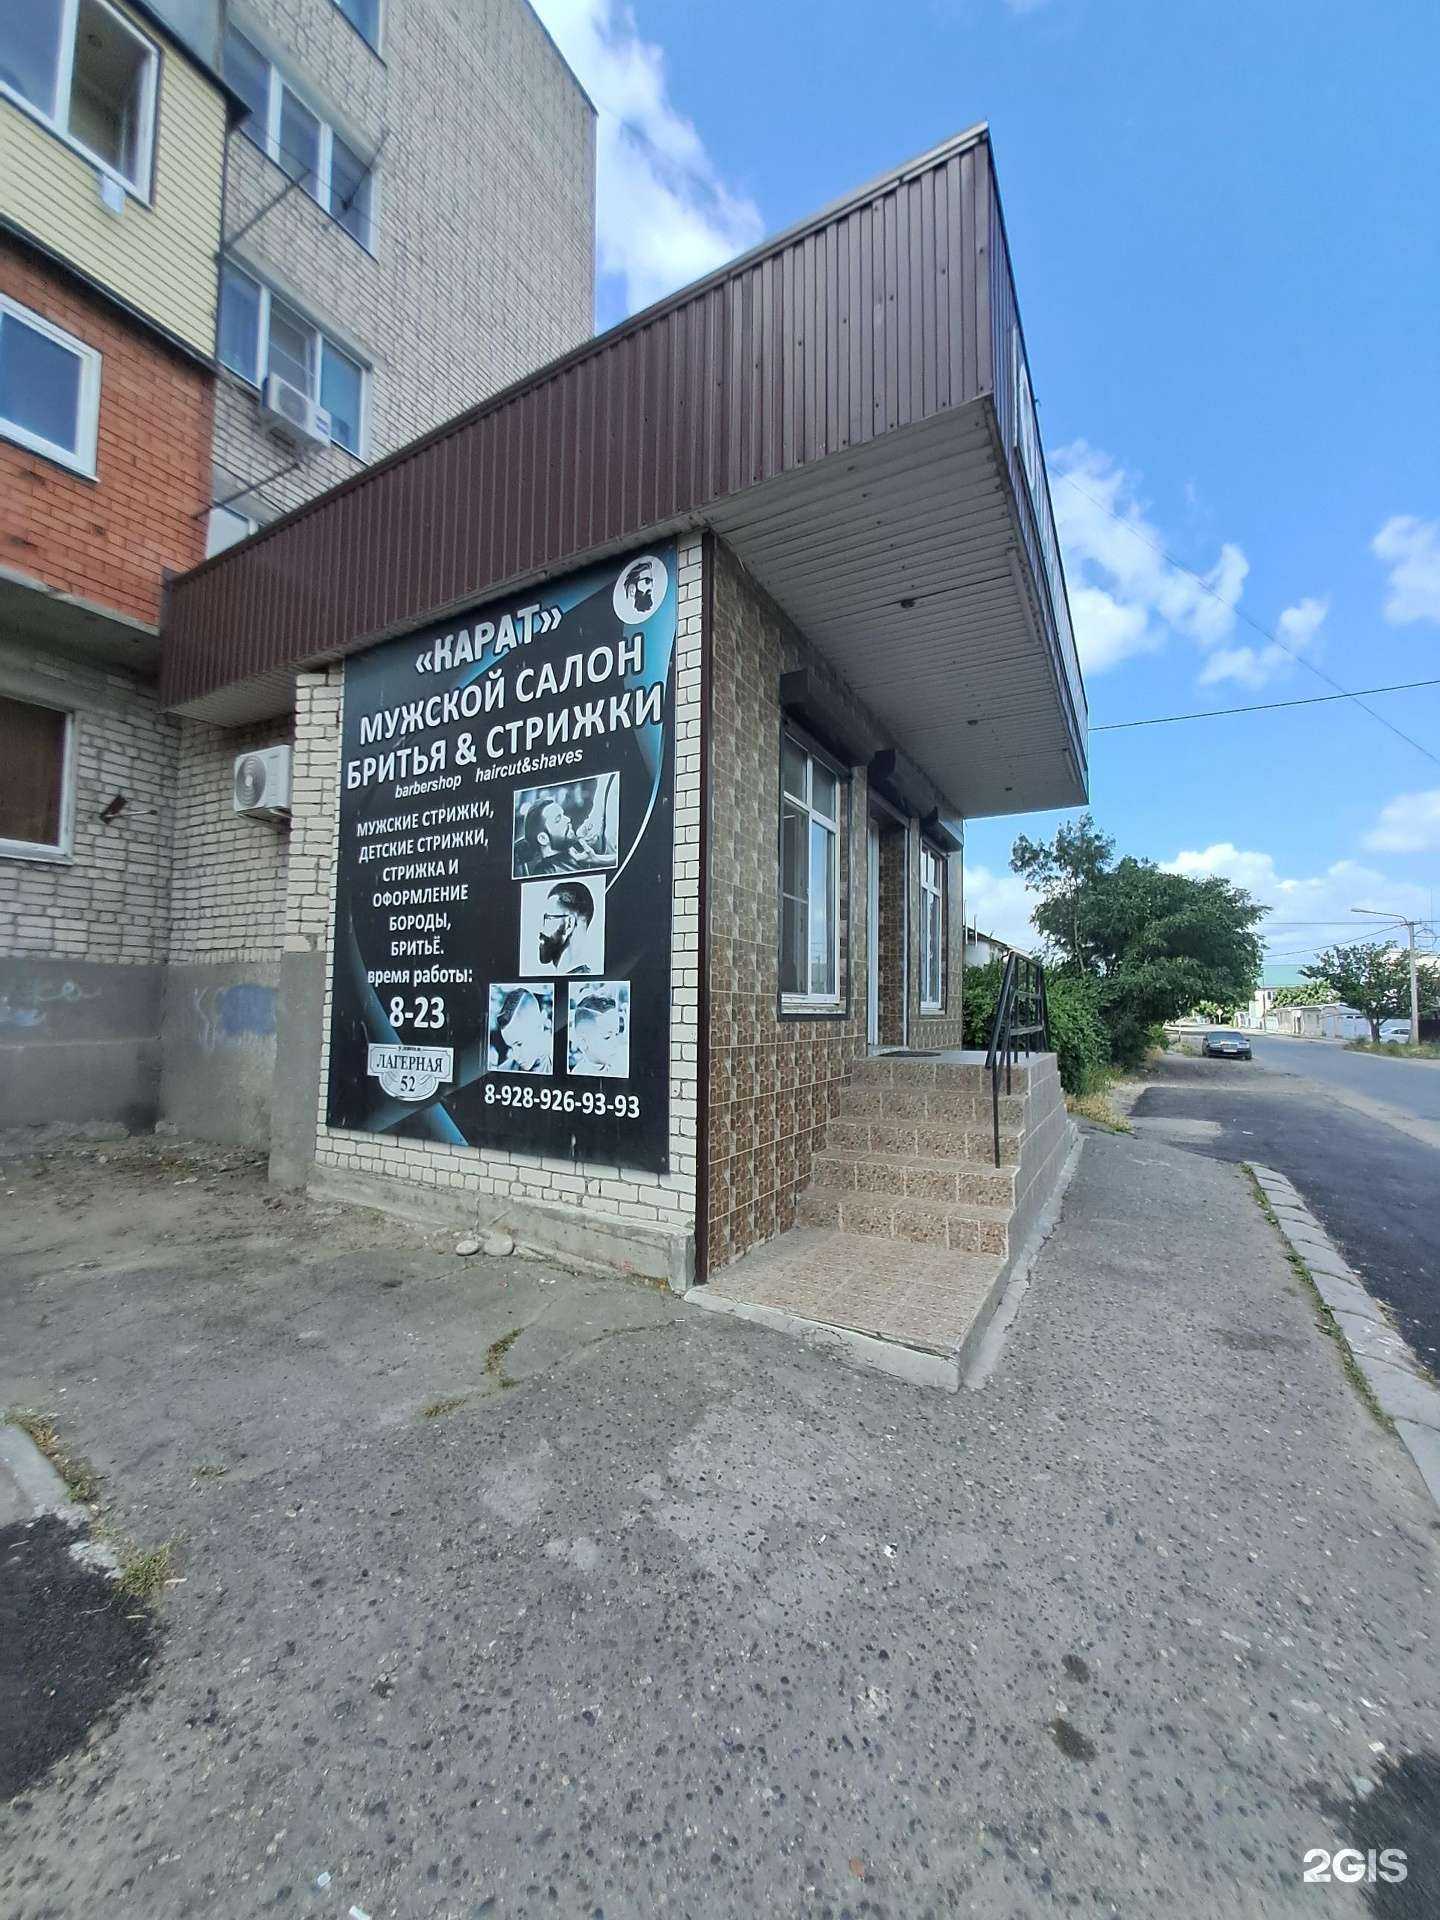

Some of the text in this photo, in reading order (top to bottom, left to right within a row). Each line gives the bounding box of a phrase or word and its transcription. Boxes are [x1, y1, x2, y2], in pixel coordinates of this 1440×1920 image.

[415, 603, 562, 674] «КАРАТ»
[359, 635, 643, 745] МУЖСКОЙ САЛОН
[346, 683, 664, 789] БРИТЬЯ & СТРИЖКИ
[394, 750, 584, 799] barbershop haircut&shaves
[356, 801, 495, 837] МУЖСКИЕ СТРИЖКИ,
[359, 829, 489, 863] ДЕТСКИЕ СТРИЖКИ,
[382, 859, 459, 883] СТРИЖКА И
[372, 885, 469, 908] ОФОРМЛЕНИЕ
[389, 912, 452, 932] БОРОДЫ,
[391, 936, 445, 956] БРИТЬЁ.
[367, 965, 474, 986] время работы:
[389, 997, 446, 1029] 8-23
[376, 1054, 444, 1073] ЛАГЕРНАЯ
[400, 1075, 417, 1093] 52
[484, 1084, 642, 1119] 8-928-926-93-93
